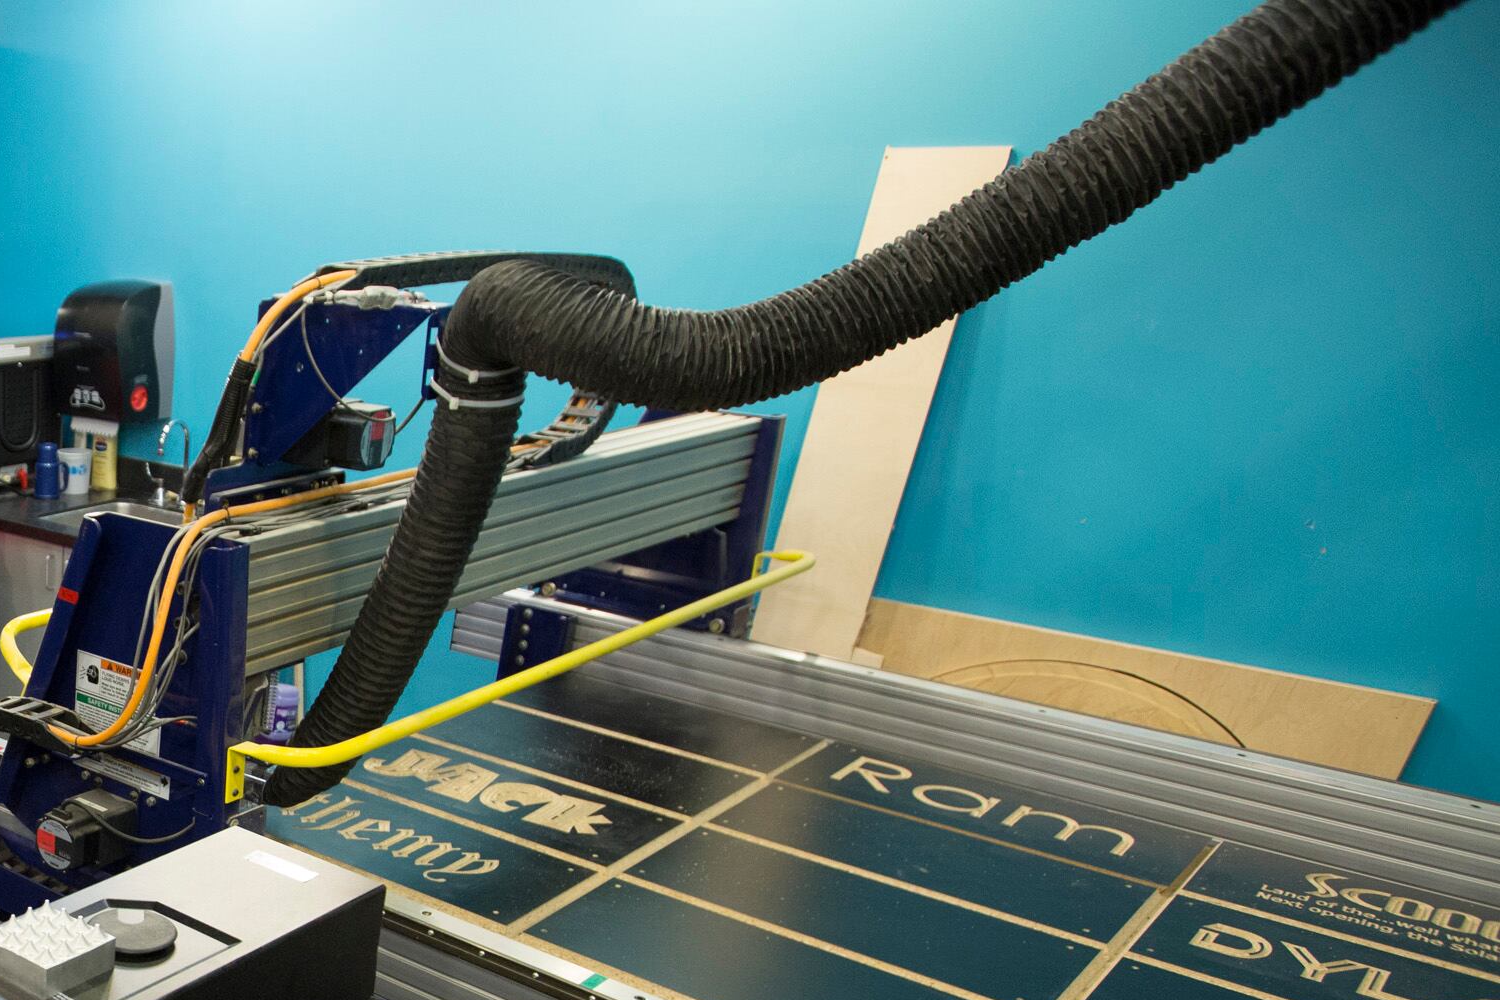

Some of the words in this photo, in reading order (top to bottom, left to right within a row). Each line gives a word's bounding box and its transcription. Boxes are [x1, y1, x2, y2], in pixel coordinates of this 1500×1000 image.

[87, 697, 108, 710] SAFETY
[363, 748, 613, 836] JACK
[830, 756, 1136, 857] Ram
[1256, 891, 1304, 910] Next
[1407, 931, 1444, 948] the
[1260, 884, 1310, 902] Land
[1315, 899, 1338, 908] of
